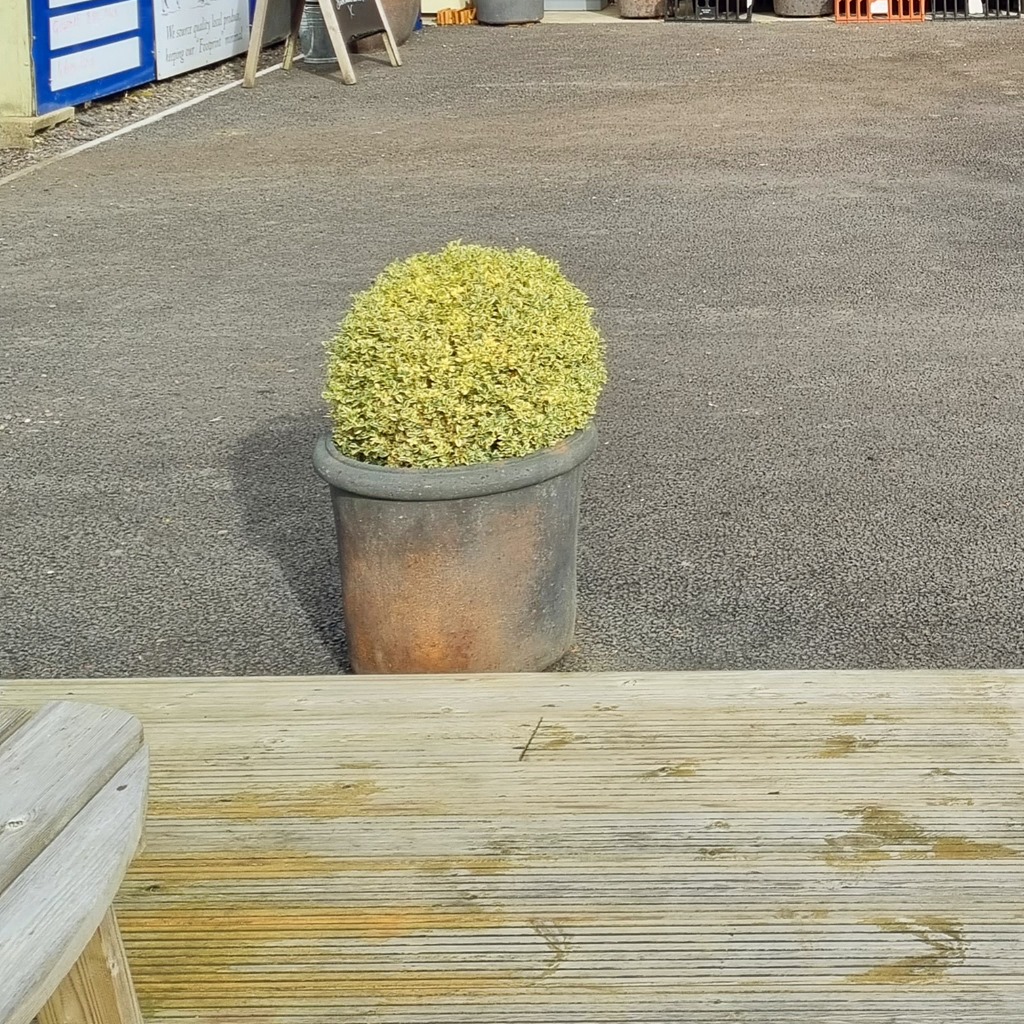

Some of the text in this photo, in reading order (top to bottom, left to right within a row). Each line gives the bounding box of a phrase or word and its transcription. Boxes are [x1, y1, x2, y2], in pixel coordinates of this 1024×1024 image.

[166, 24, 175, 40] We
[176, 25, 192, 38] source
[193, 16, 210, 38] quality
[211, 11, 222, 28] local
[165, 48, 184, 67] keeping
[185, 46, 195, 57] our
